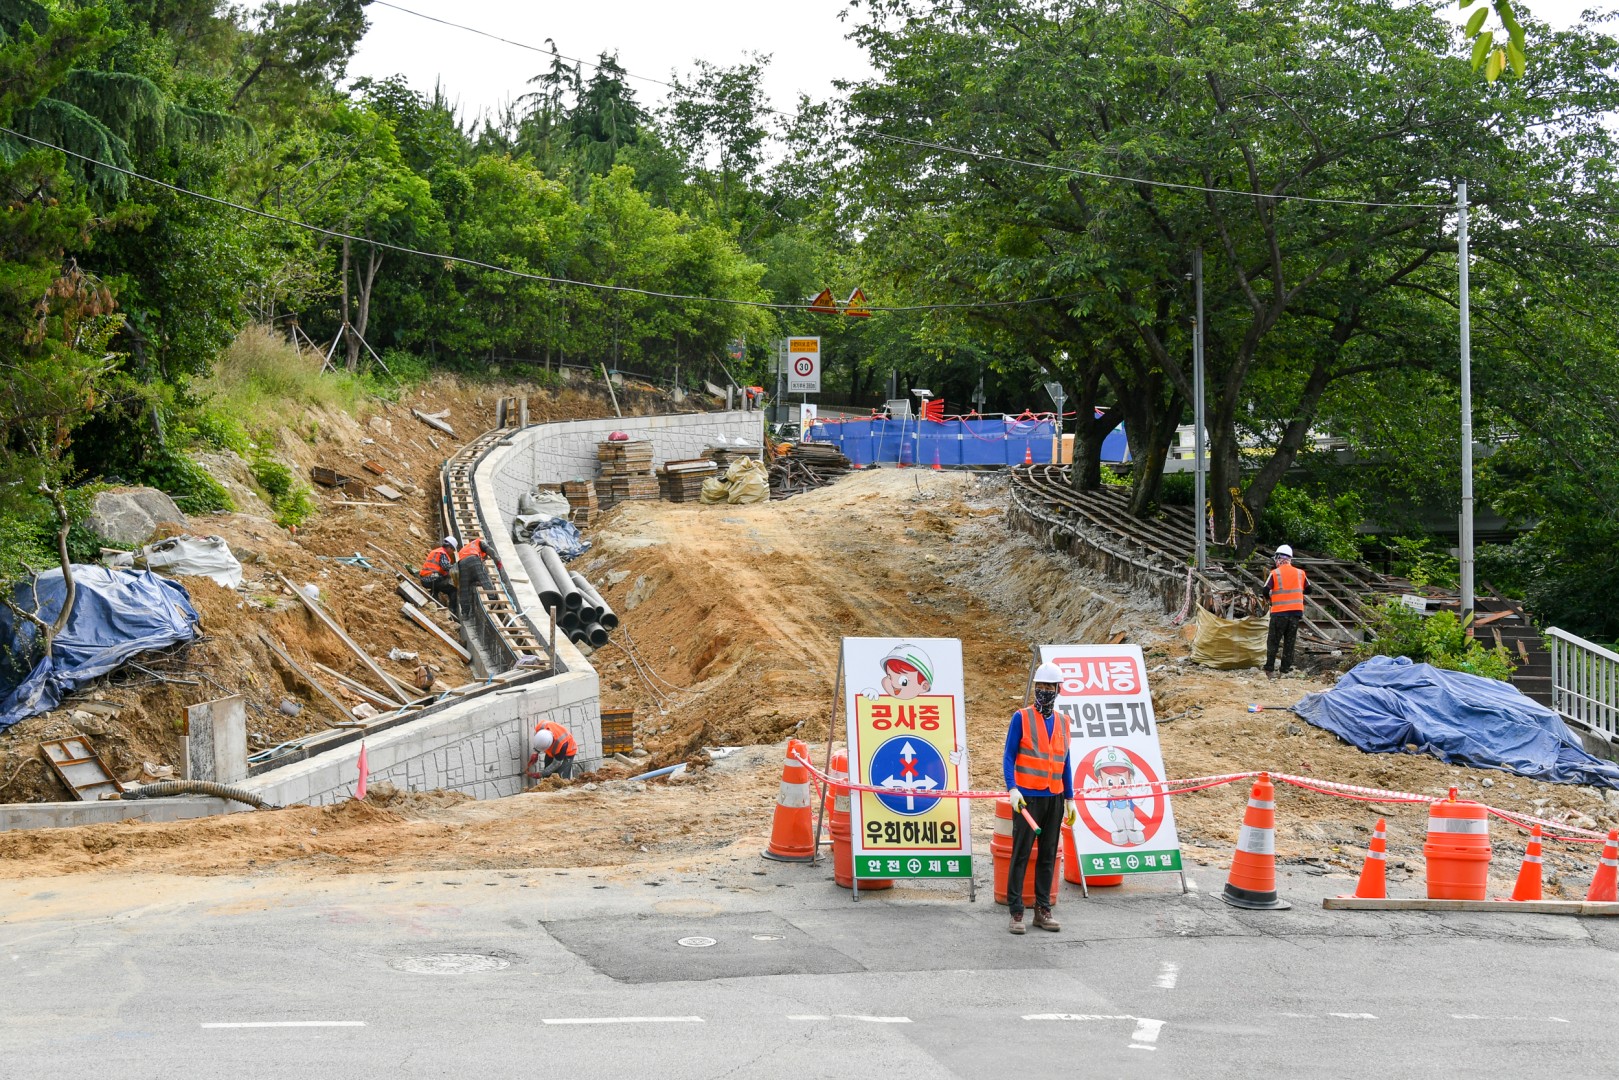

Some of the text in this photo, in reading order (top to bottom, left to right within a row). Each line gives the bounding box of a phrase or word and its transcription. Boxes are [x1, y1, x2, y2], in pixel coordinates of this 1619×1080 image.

[799, 362, 809, 371] 30
[1059, 661, 1135, 693] 공사중
[871, 704, 940, 731] 공사중
[1059, 702, 1151, 738] 진입금지
[866, 820, 957, 845] 우회하세요
[867, 859, 960, 873] 안전 제일
[1092, 853, 1172, 870] 안전 제일
